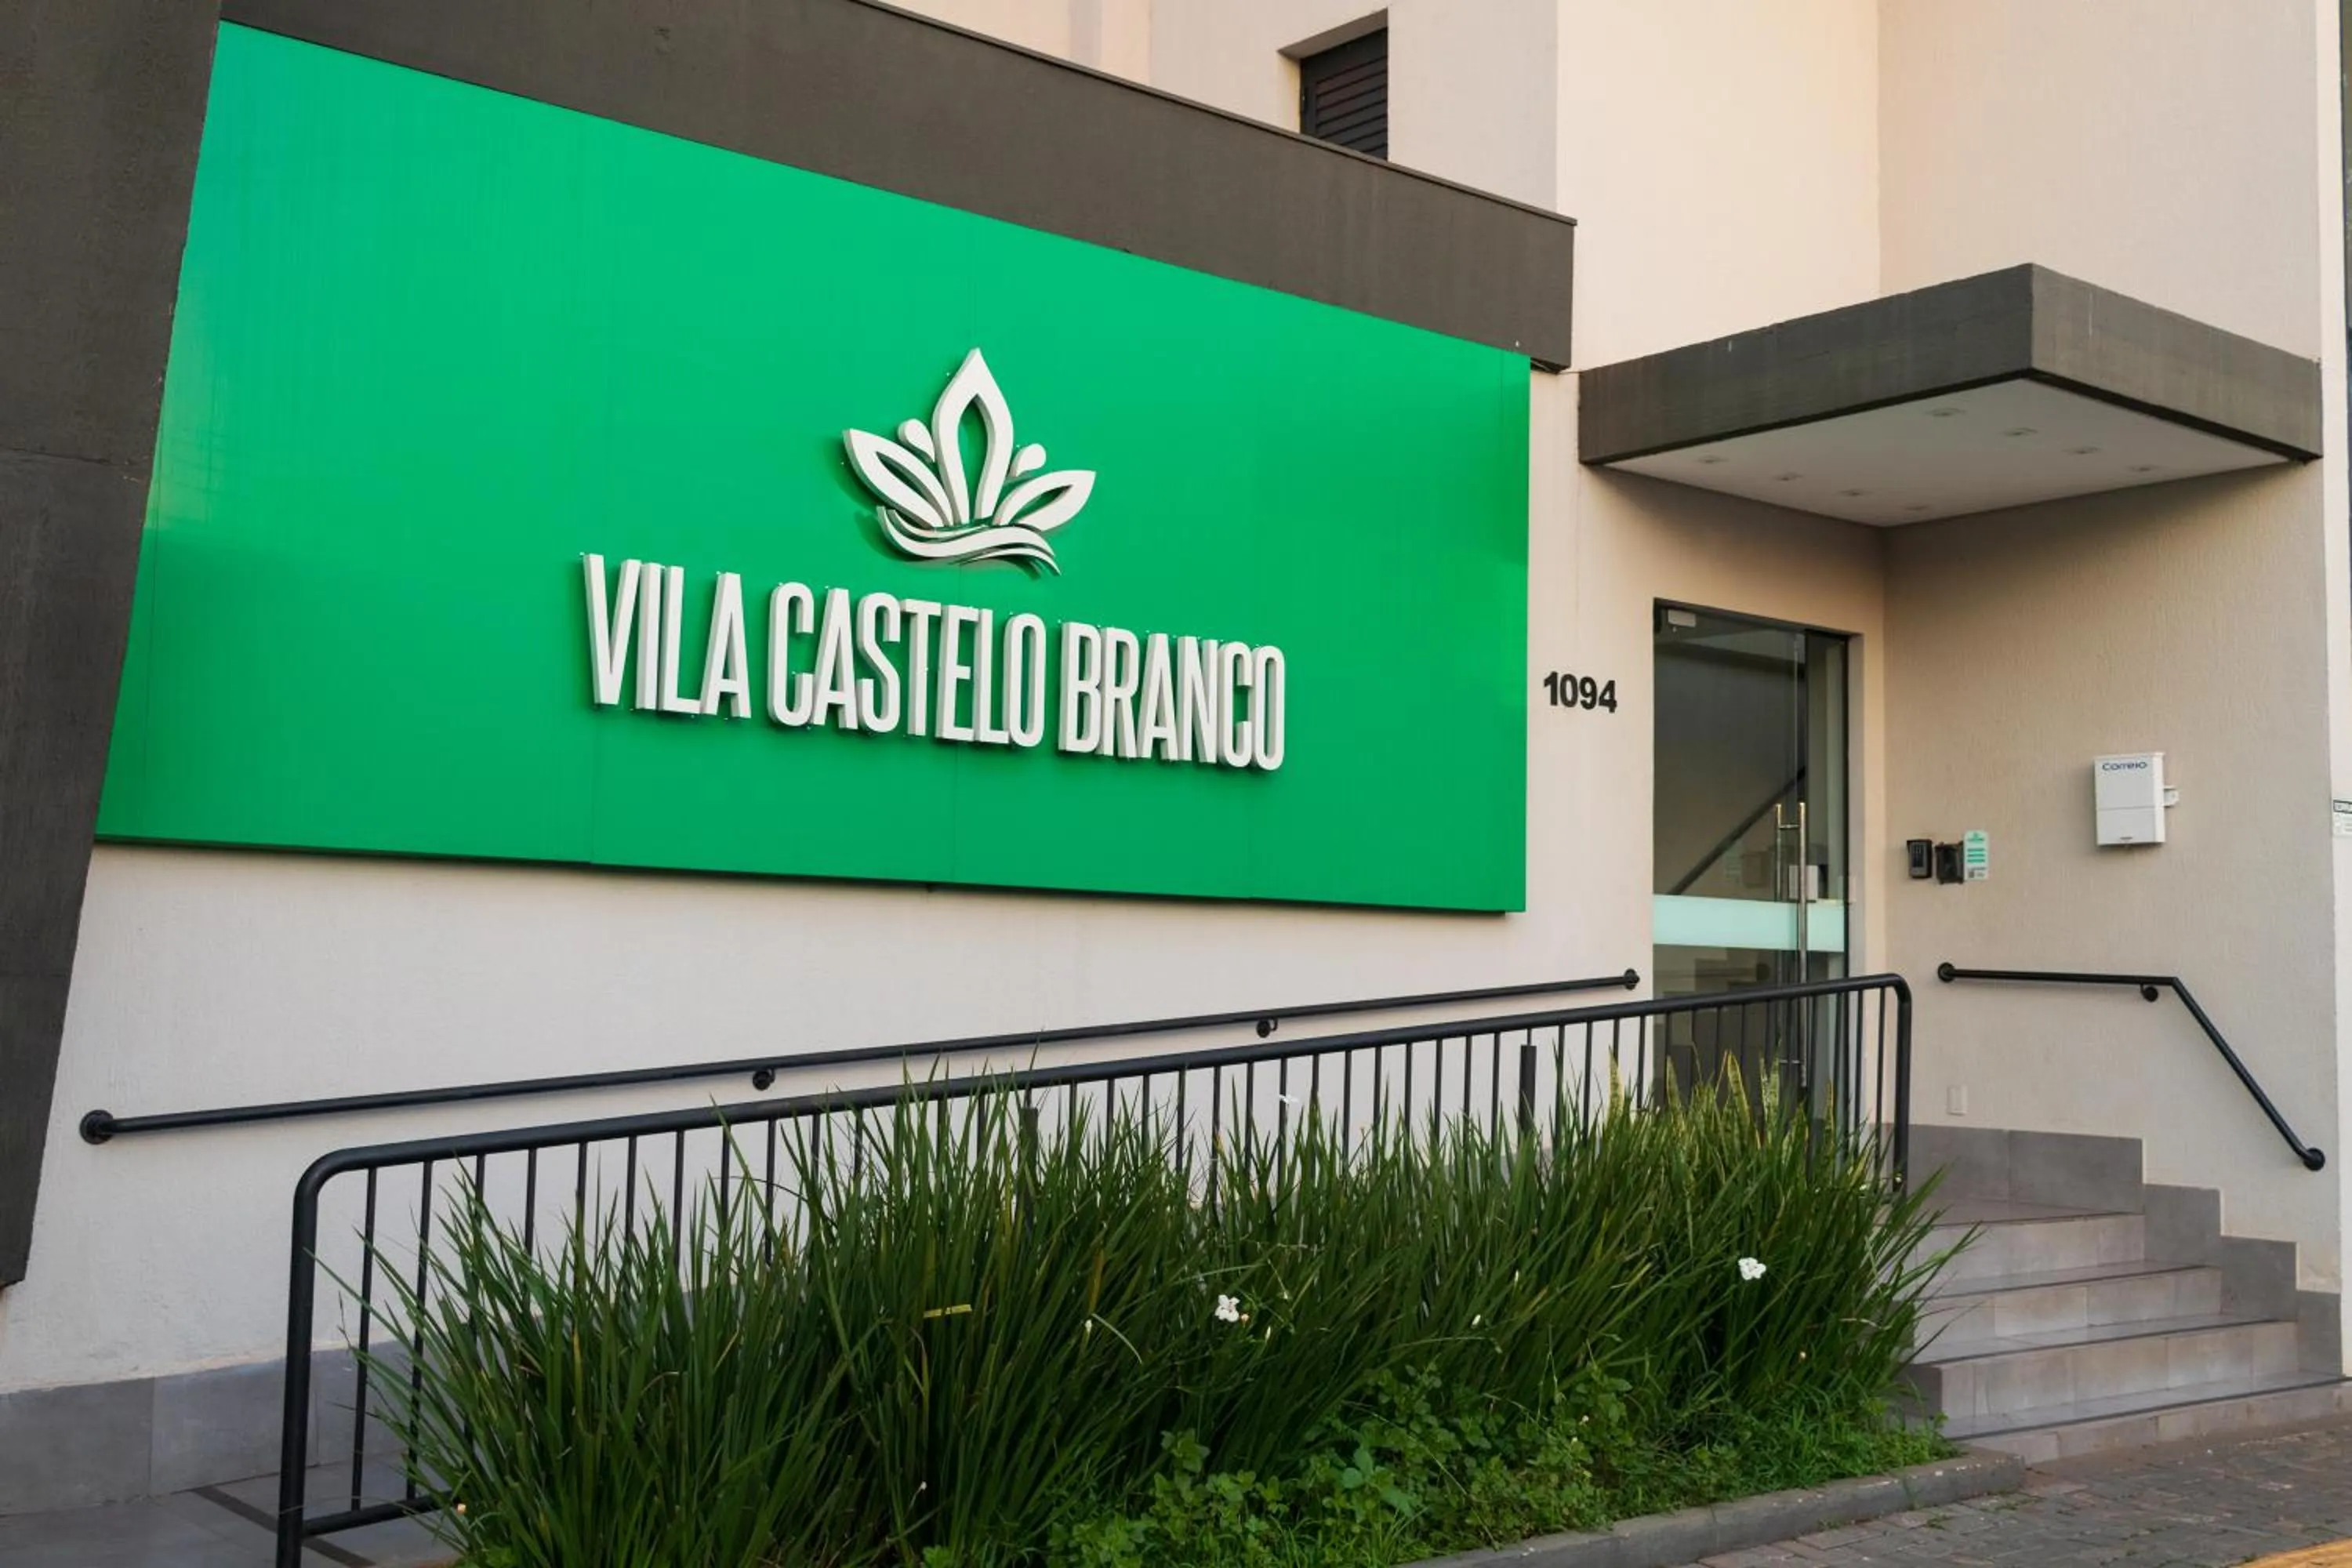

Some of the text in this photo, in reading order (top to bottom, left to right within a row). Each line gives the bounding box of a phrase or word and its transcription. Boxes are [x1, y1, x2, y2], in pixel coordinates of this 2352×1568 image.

[583, 554, 1285, 770] VILA CASTELO BRANCO
[1544, 671, 1617, 713] 1094
